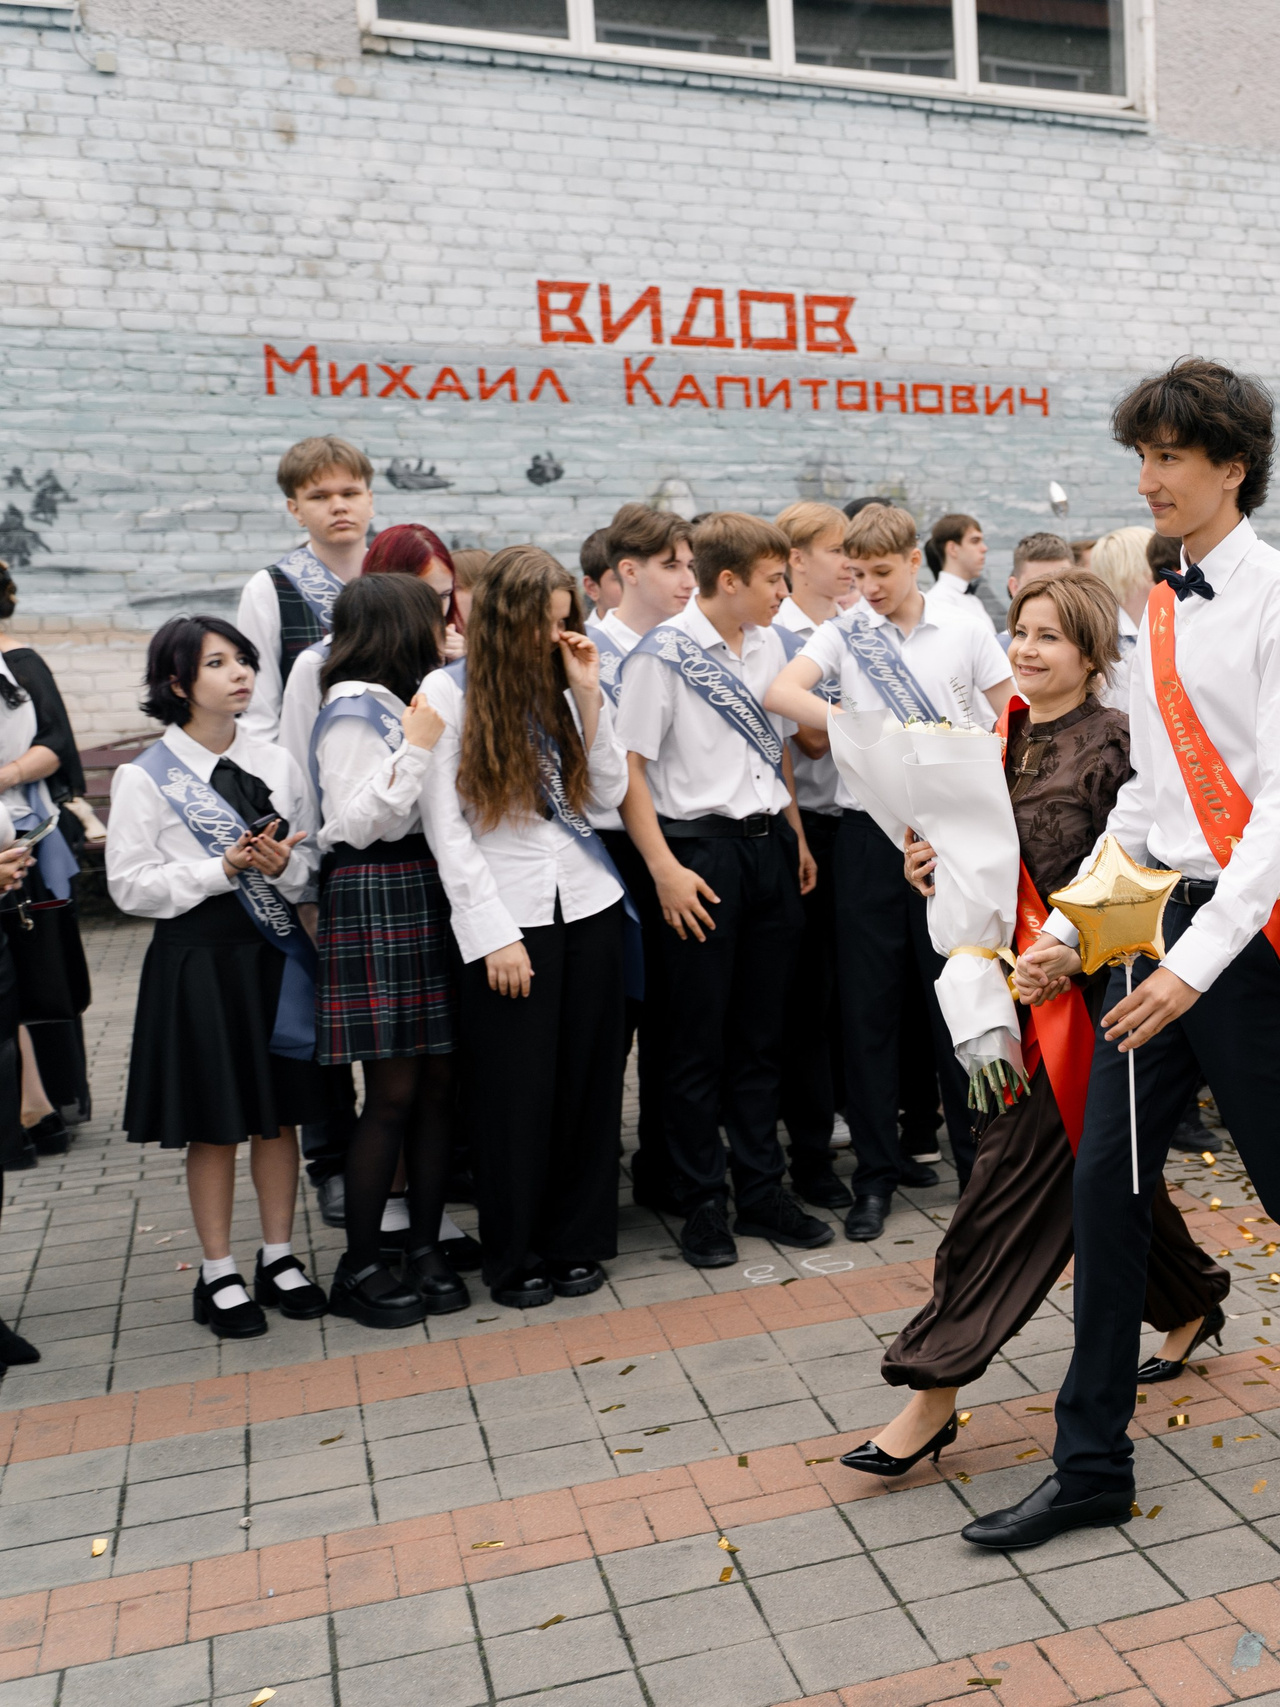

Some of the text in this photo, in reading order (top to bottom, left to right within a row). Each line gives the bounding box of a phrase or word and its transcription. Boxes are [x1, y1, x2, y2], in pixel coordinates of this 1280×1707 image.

[537, 280, 858, 353] ВИДОВ
[682, 653, 768, 737] Выпускник
[1160, 659, 1230, 824] Выпускник
[1210, 757, 1233, 797] Вадим
[263, 902, 297, 935] 2026
